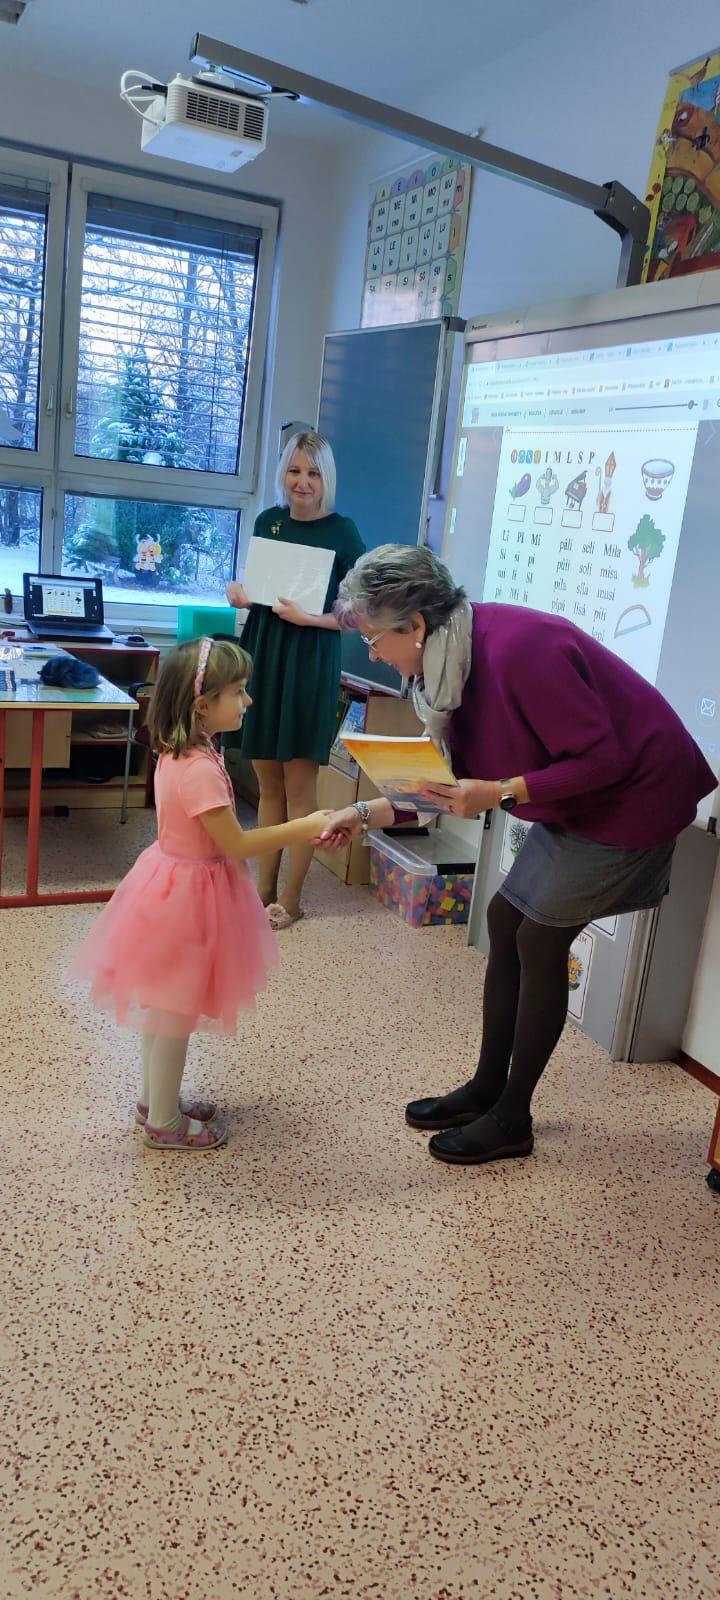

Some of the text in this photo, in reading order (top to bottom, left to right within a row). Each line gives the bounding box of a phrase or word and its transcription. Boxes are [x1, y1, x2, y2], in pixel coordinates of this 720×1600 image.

[552, 450, 562, 464] M
[566, 451, 573, 464] L
[577, 451, 584, 464] S
[588, 451, 596, 465] P
